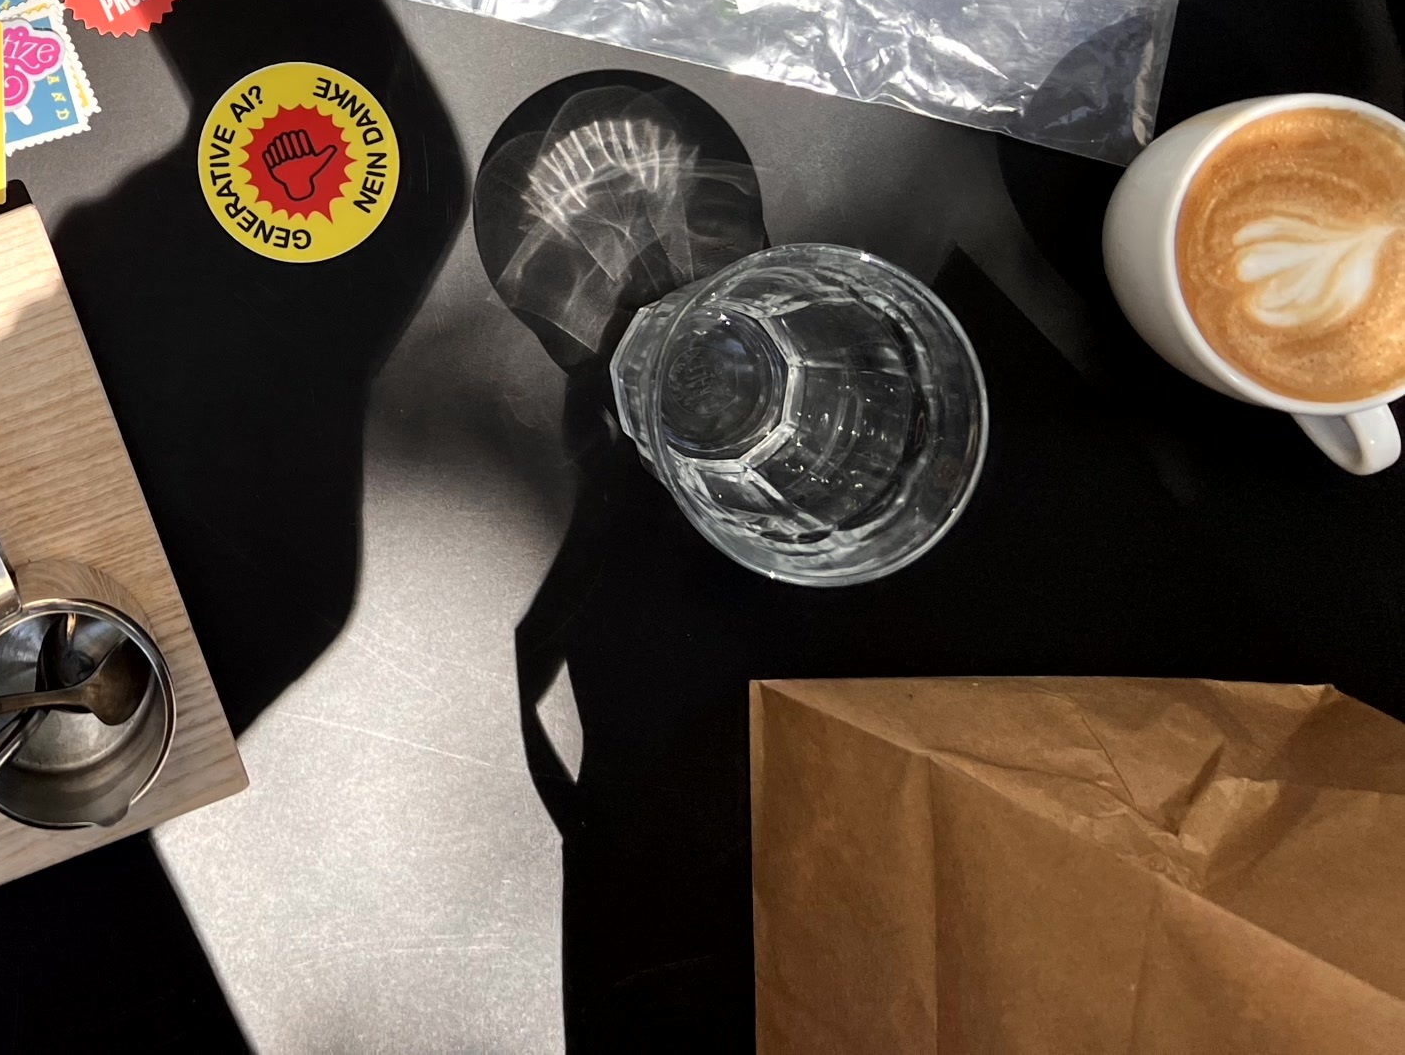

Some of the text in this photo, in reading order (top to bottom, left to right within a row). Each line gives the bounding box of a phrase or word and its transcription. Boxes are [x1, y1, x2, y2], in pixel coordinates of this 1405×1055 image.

[210, 85, 311, 250] GENERATIVE AI?
[313, 77, 387, 213] NEIN DANKE
